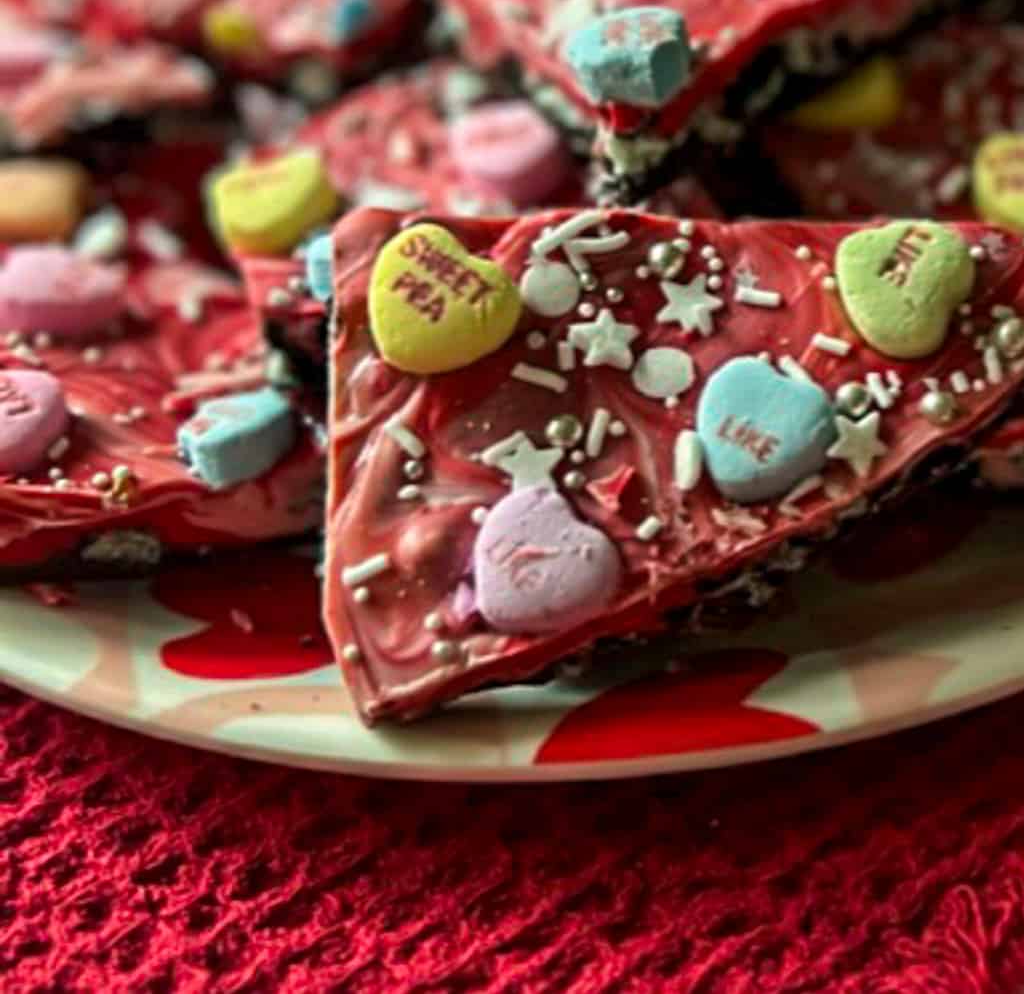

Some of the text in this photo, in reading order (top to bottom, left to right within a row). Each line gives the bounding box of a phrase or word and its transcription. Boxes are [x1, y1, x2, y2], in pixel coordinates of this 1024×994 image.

[399, 233, 492, 305] SWEET
[392, 272, 445, 323] PEA
[717, 415, 780, 462] LIKE
